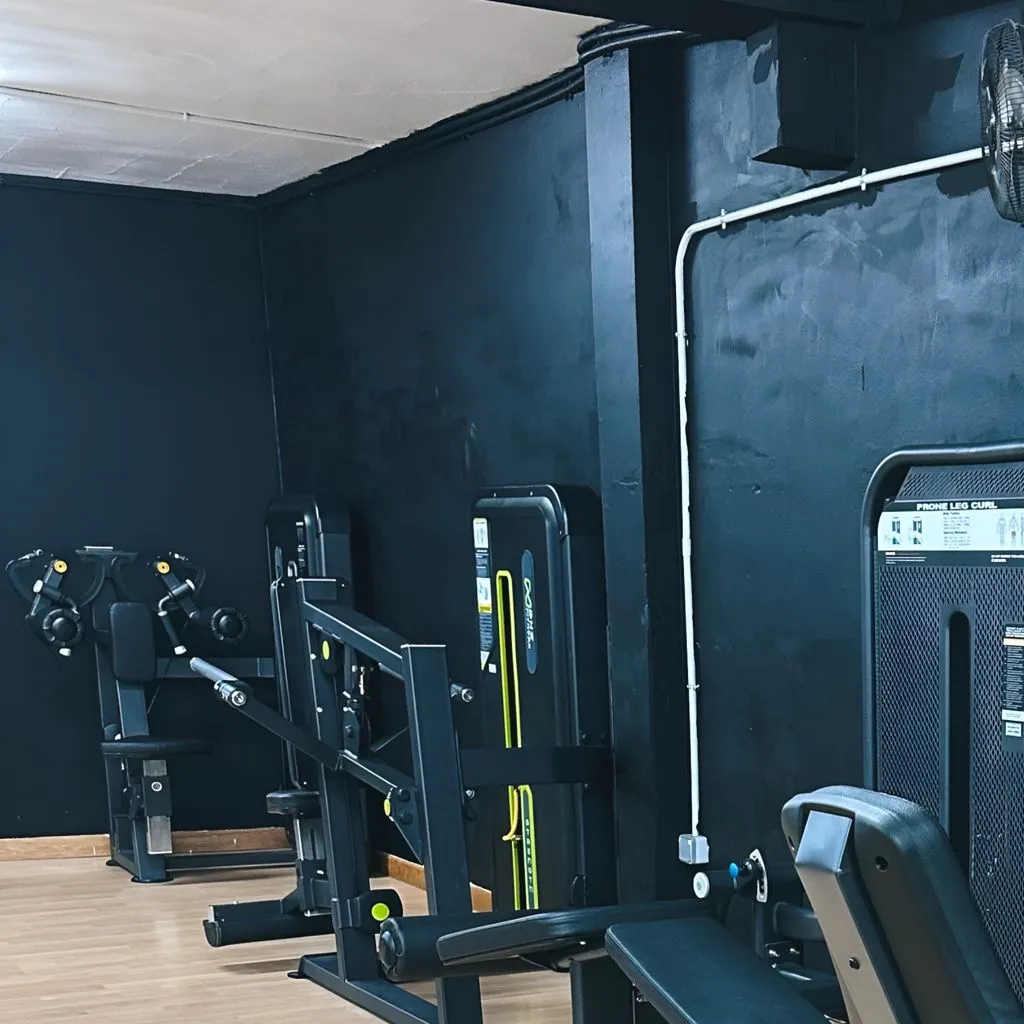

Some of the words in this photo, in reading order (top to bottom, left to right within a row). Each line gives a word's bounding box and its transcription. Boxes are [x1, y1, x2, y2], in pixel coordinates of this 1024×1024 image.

[916, 502, 948, 511] PRONE
[950, 502, 969, 510] LEG
[971, 501, 998, 510] CURL
